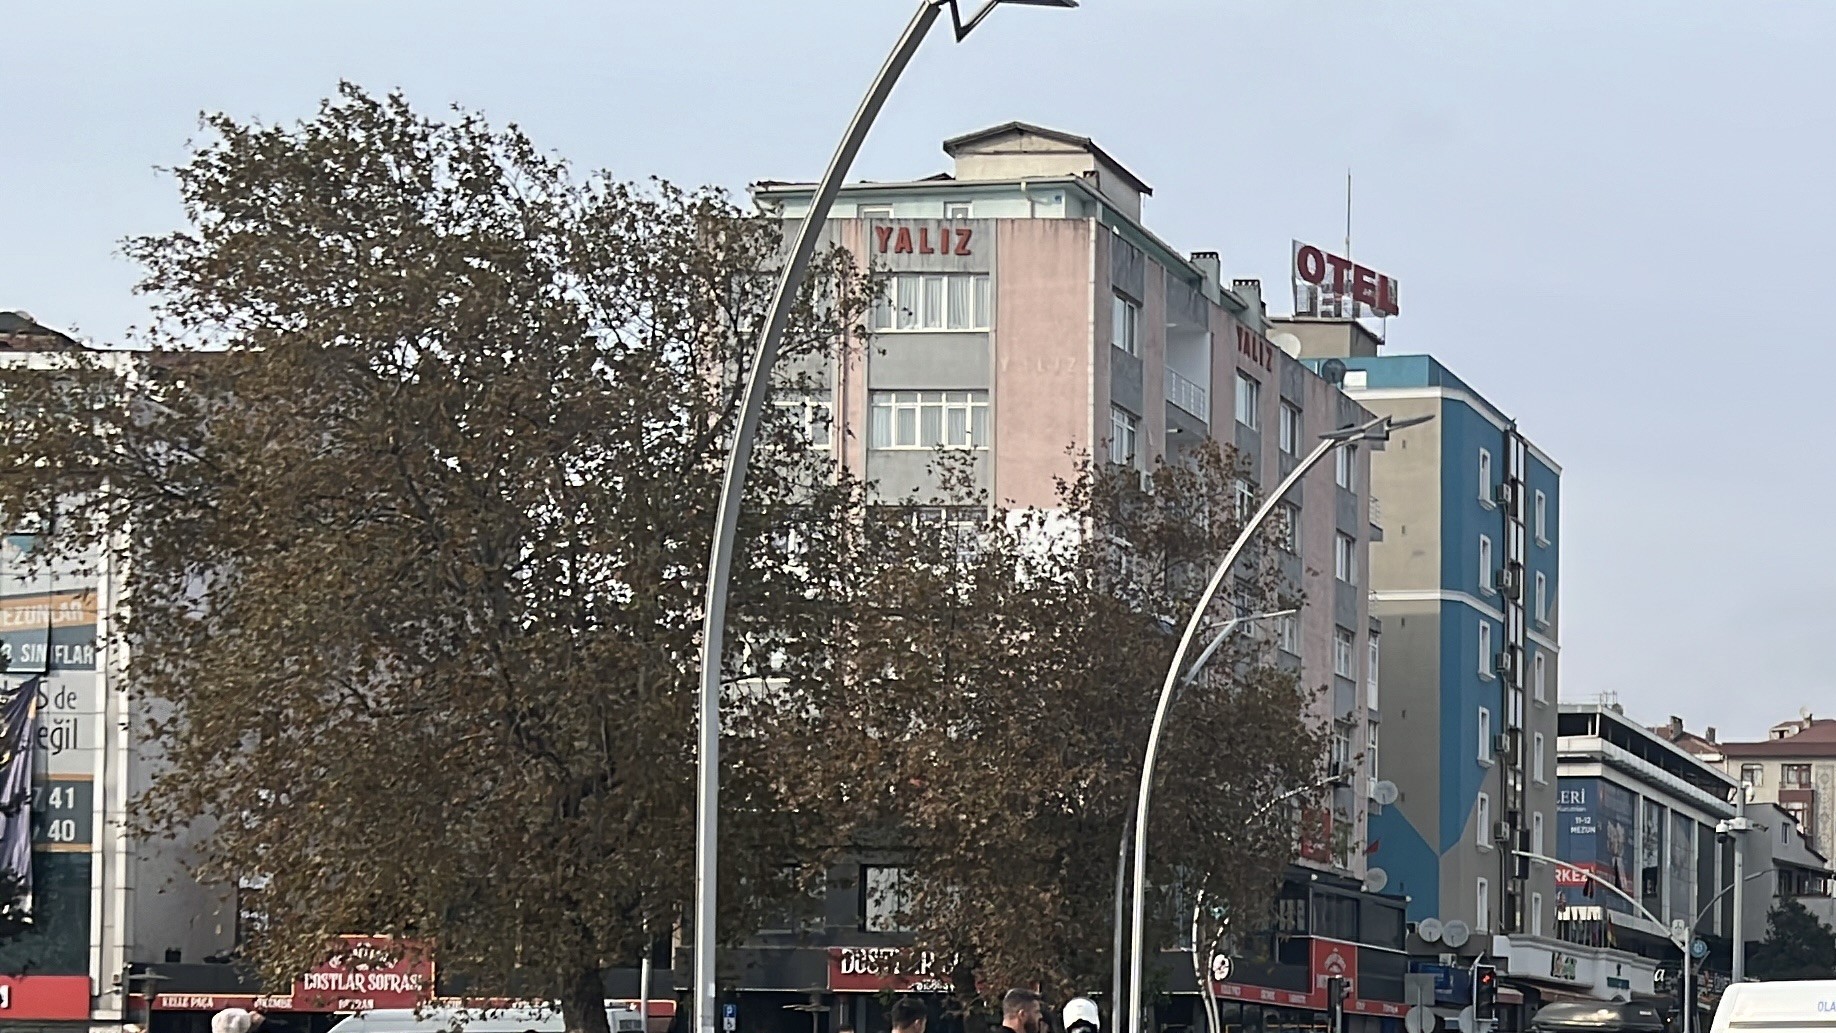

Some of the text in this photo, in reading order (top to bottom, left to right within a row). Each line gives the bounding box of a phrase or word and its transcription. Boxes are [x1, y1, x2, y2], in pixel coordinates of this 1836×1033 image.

[875, 226, 972, 256] YALIZ
[1297, 245, 1399, 316] OTEL
[1236, 325, 1273, 373] YALIZ
[55, 685, 77, 709] de
[37, 718, 78, 755] eğil
[49, 787, 75, 809] 41
[47, 819, 76, 842] 40
